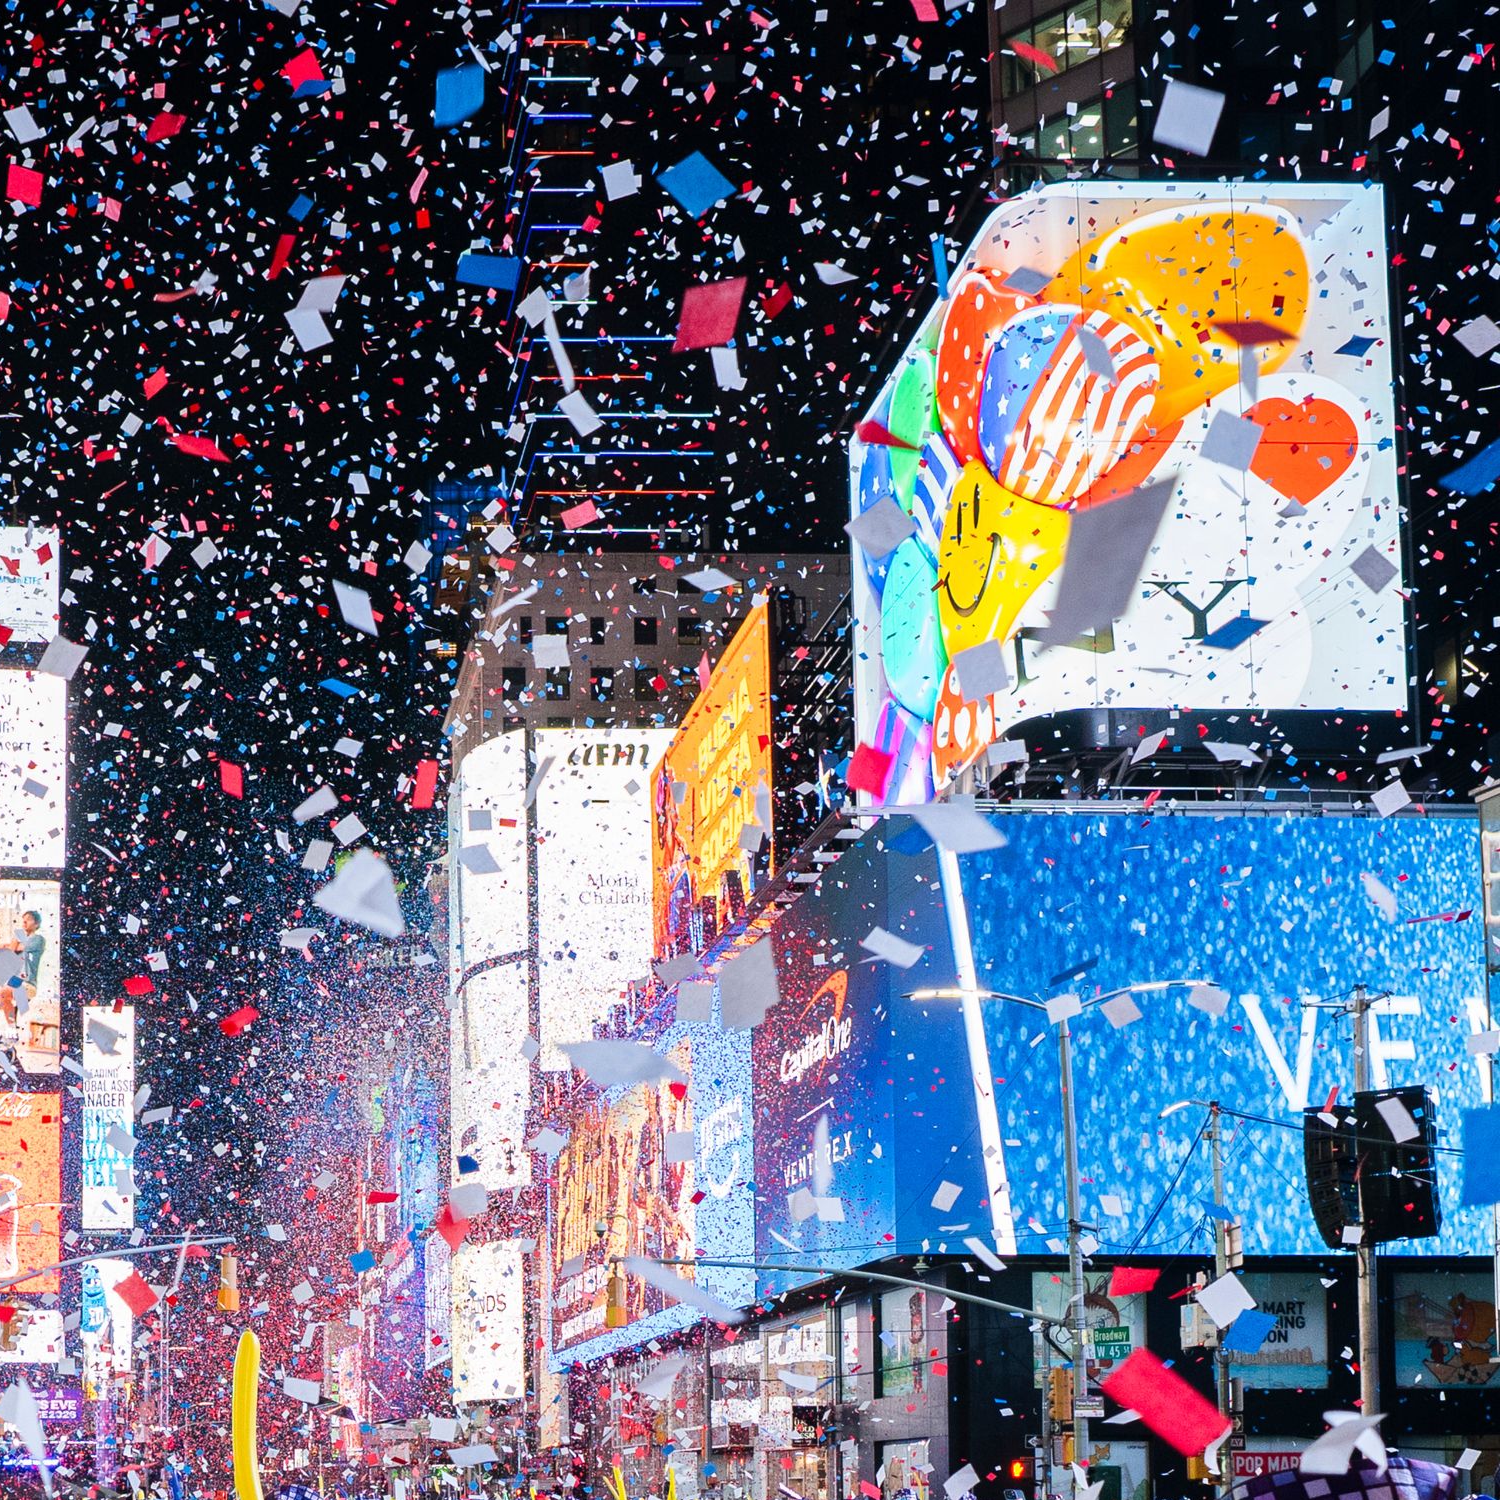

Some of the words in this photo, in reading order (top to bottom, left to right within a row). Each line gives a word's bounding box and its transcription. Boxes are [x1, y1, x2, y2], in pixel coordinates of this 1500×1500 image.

[698, 676, 751, 778] BUENA
[700, 730, 752, 828] VISTA
[1263, 1302, 1305, 1314] MART
[1275, 1316, 1305, 1329] ING
[1094, 1330, 1127, 1342] Broadway
[1097, 1347, 1106, 1357] W
[1109, 1346, 1121, 1357] 45
[51, 1400, 77, 1410] EVE
[1236, 1456, 1263, 1473] POP
[1268, 1456, 1302, 1473] MAR
